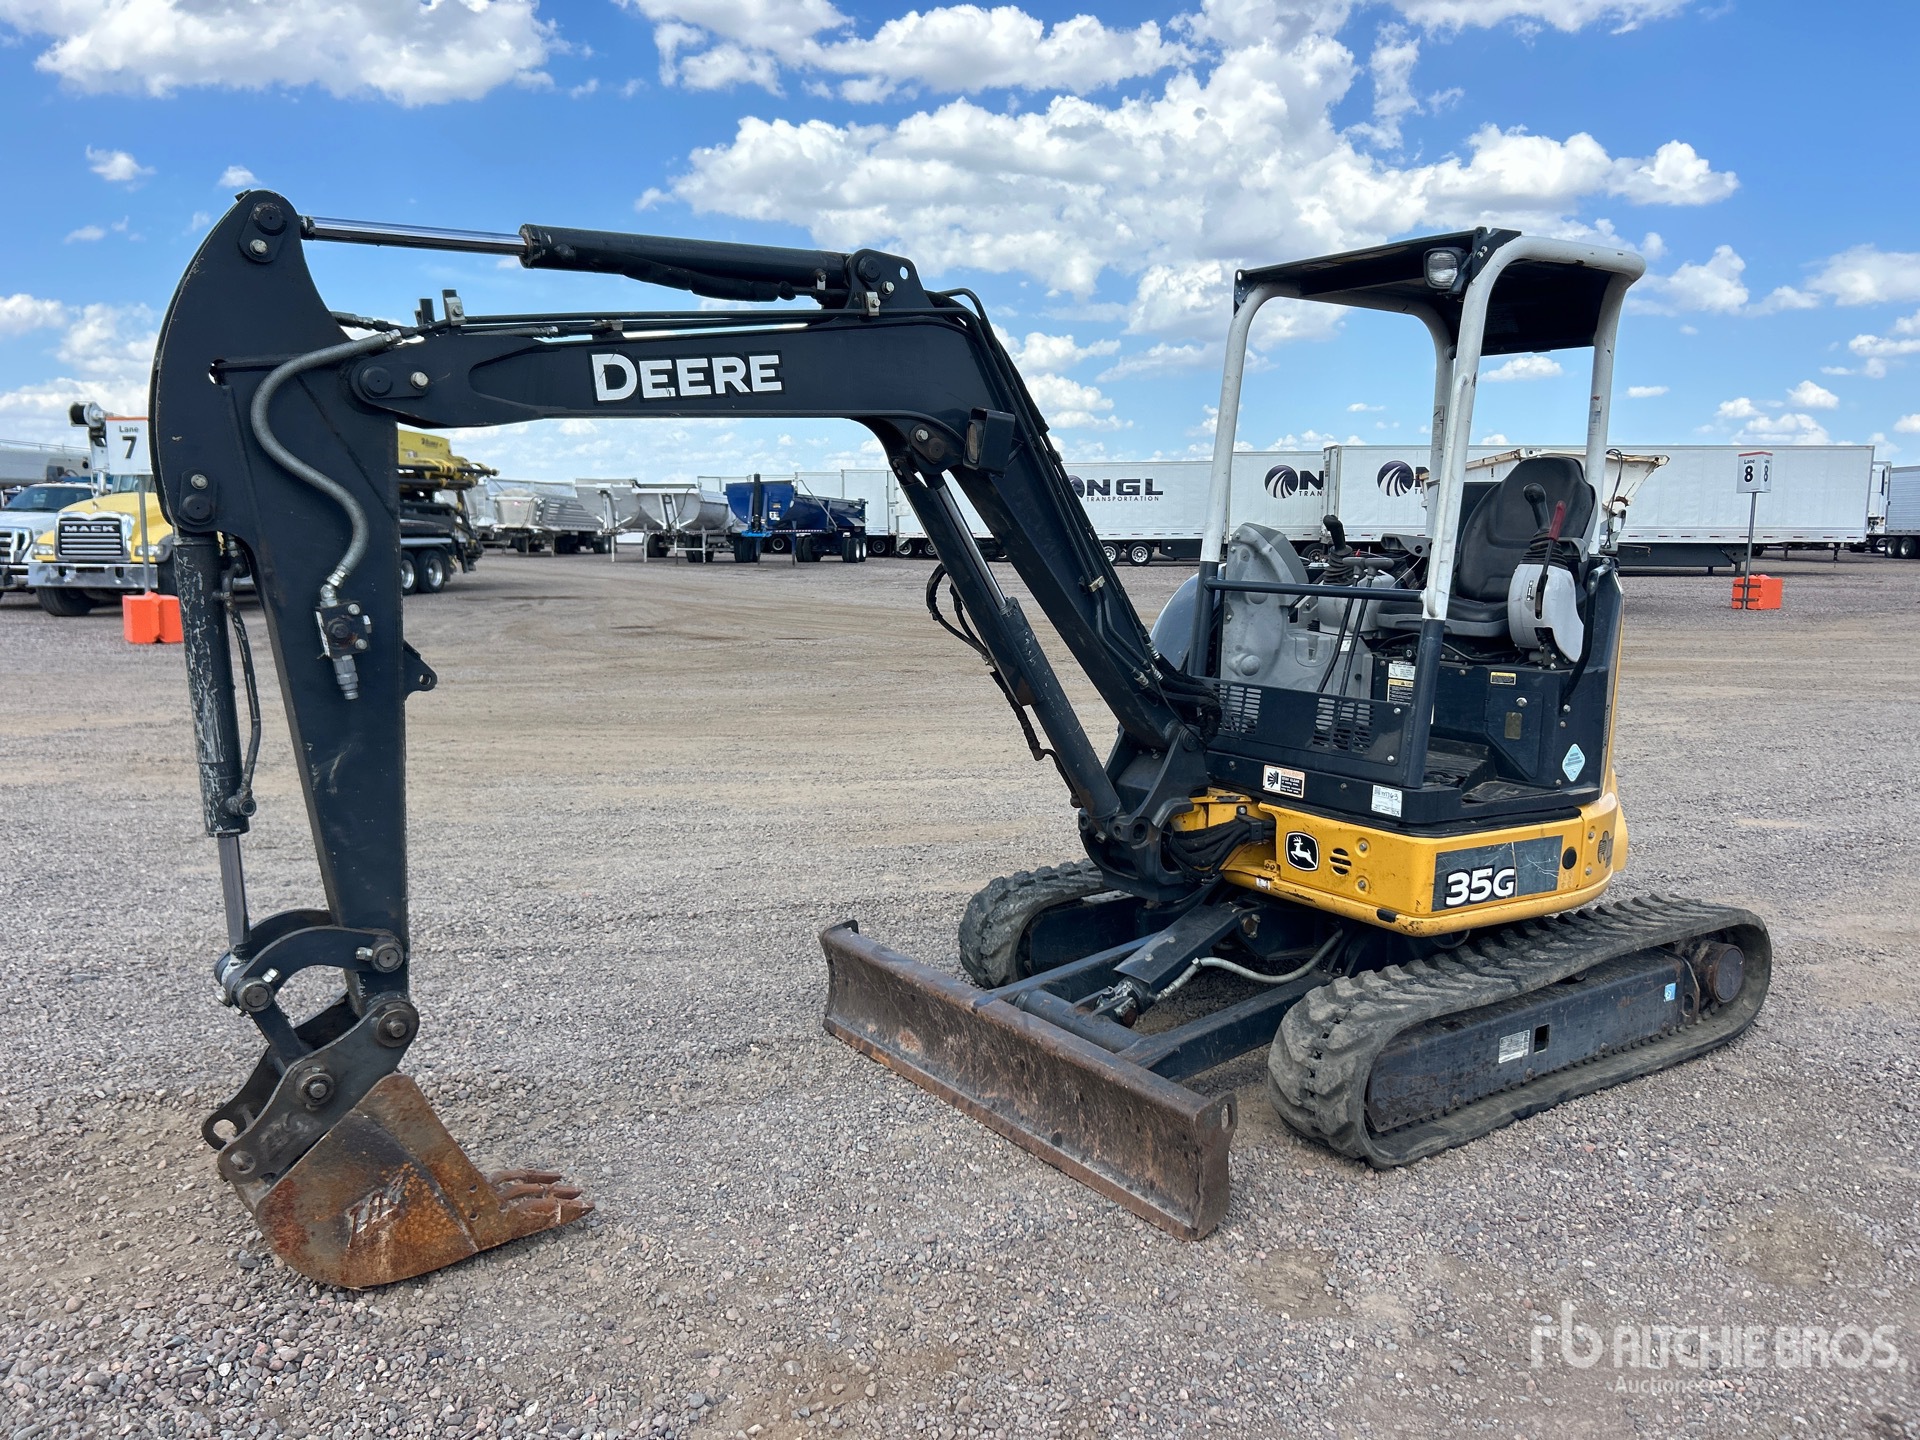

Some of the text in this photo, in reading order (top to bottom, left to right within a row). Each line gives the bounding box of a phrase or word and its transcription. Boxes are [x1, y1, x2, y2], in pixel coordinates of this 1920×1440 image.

[590, 353, 783, 402] DEERE
[118, 425, 139, 433] Lane
[122, 435, 137, 459] 7
[1744, 465, 1754, 482] 8
[1763, 464, 1769, 482] 8
[1086, 478, 1164, 496] NGL
[1445, 867, 1516, 906] 35G
